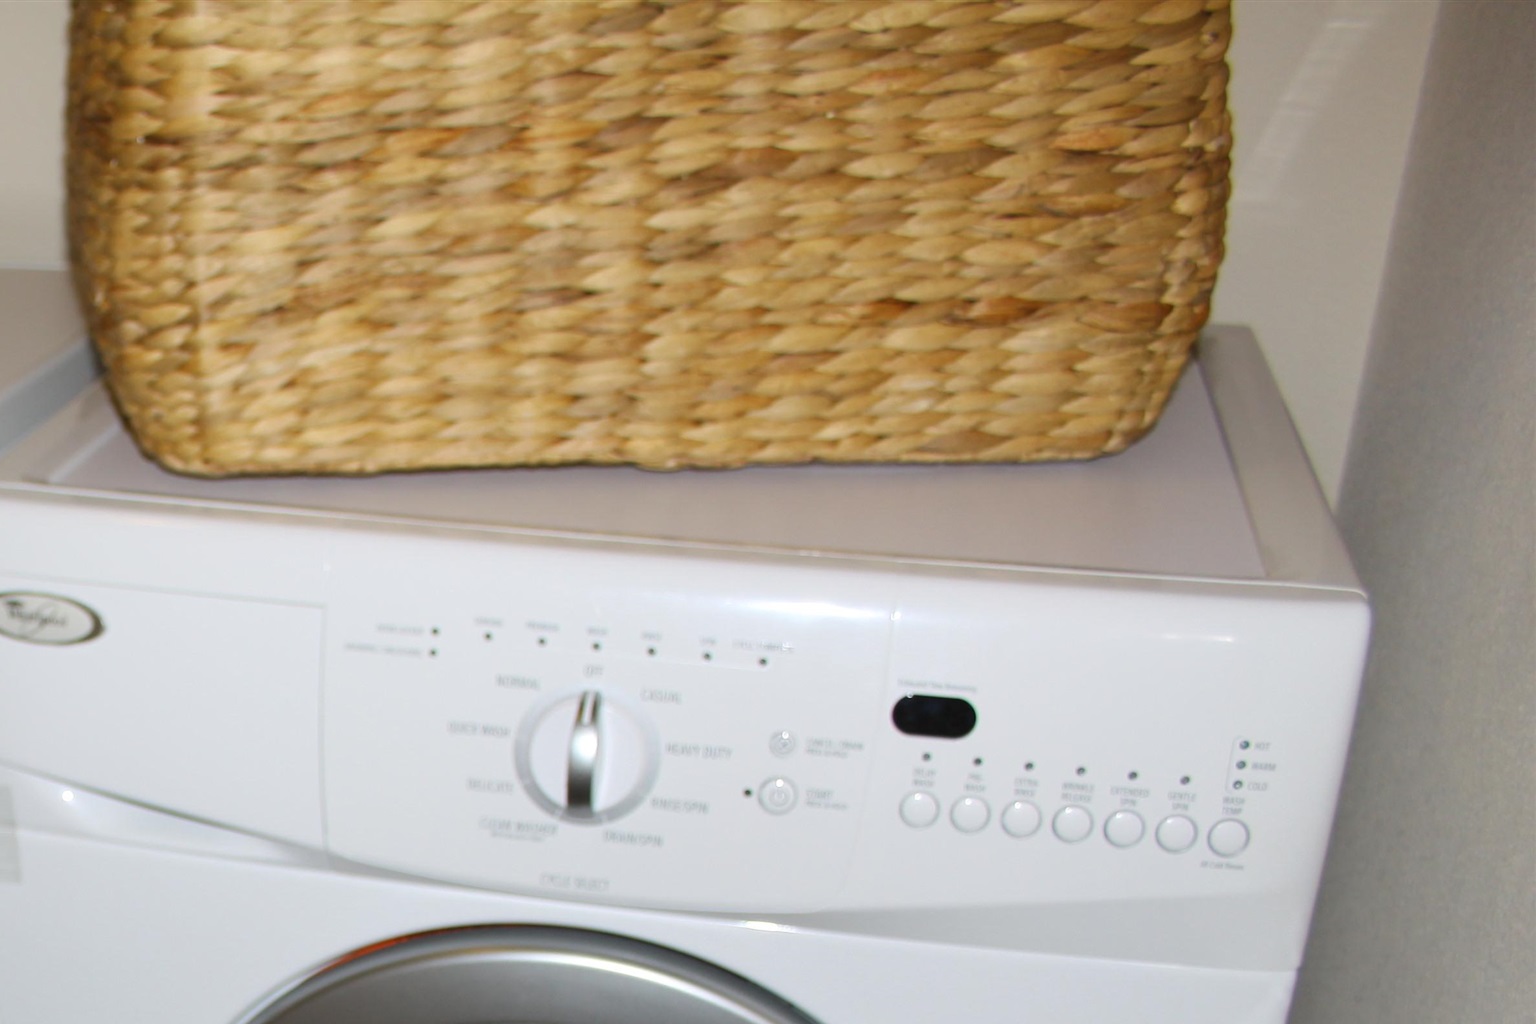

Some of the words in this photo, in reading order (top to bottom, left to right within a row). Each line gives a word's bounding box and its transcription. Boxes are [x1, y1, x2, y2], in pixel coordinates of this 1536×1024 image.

[495, 674, 539, 690] NORMAL
[640, 686, 682, 703] CASUAL
[482, 724, 510, 738] WASH
[665, 742, 700, 756] HEAVY
[702, 745, 732, 759] DUTY
